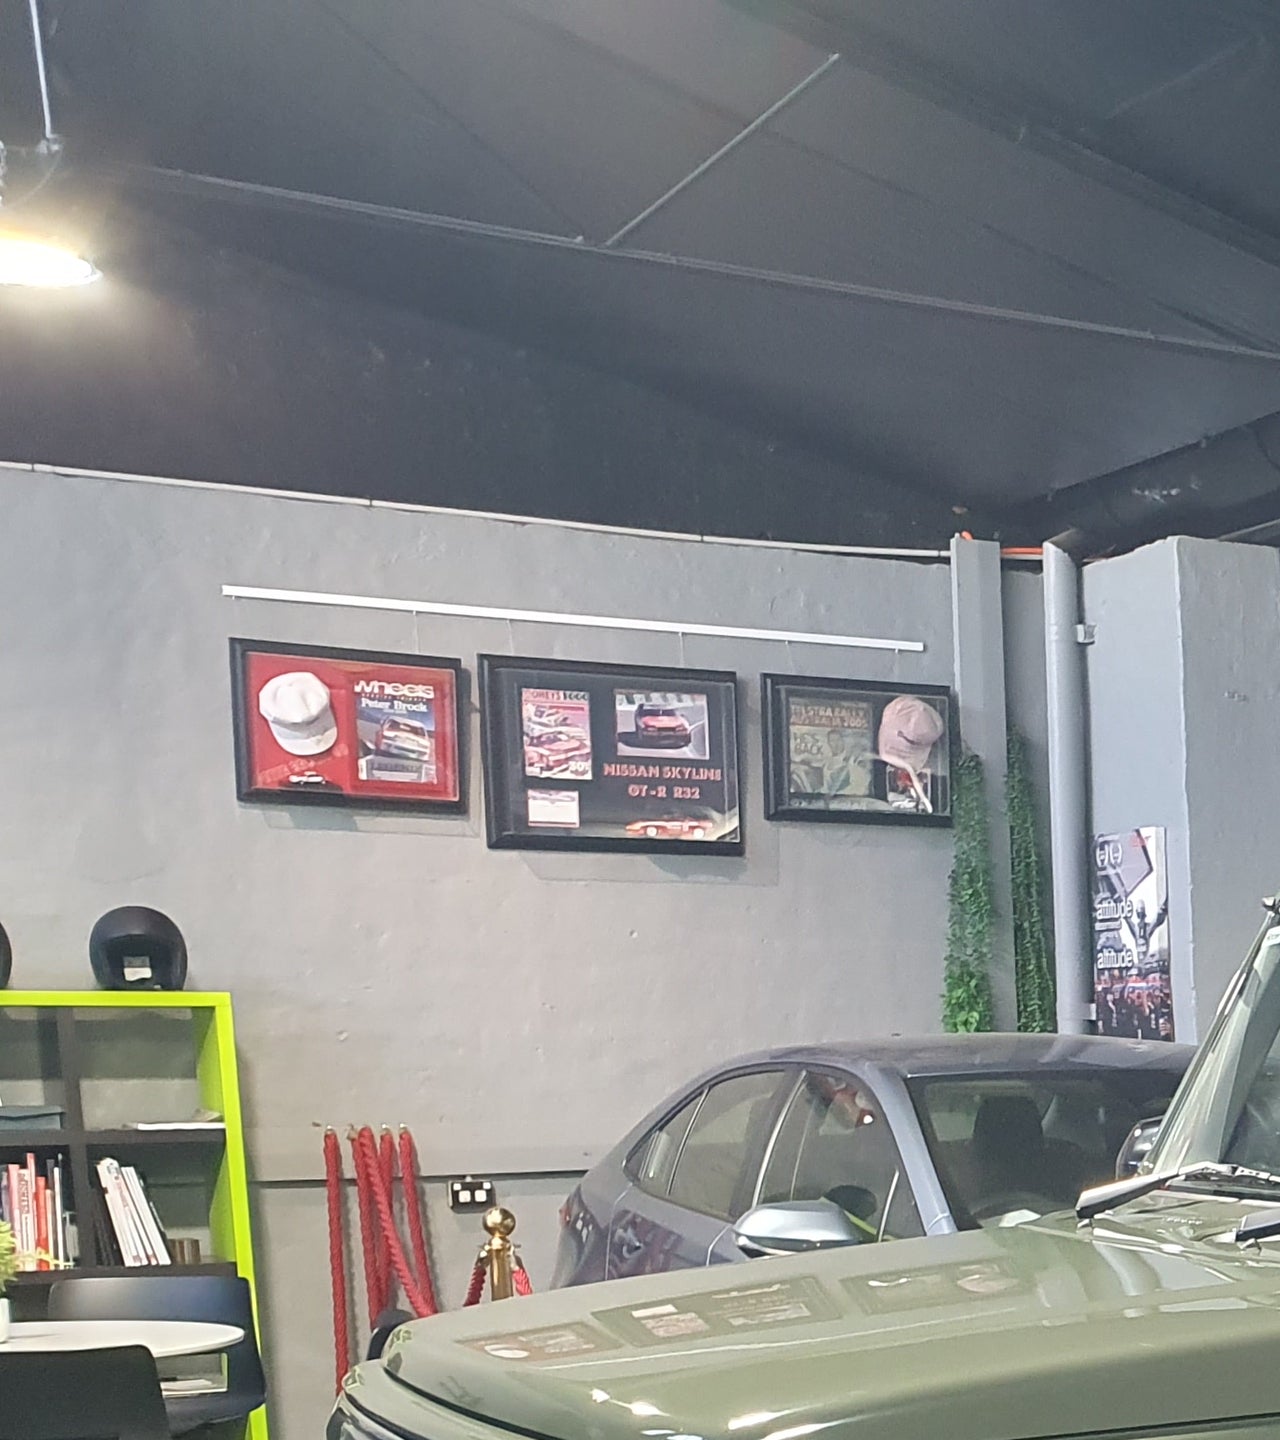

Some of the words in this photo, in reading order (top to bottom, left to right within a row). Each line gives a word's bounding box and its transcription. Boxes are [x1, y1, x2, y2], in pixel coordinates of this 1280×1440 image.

[354, 680, 435, 699] wheels
[361, 698, 391, 710] Peter
[394, 701, 428, 712] Brock
[603, 763, 660, 778] NISSAN
[662, 765, 722, 781] SKYLINE
[673, 786, 700, 799] R32
